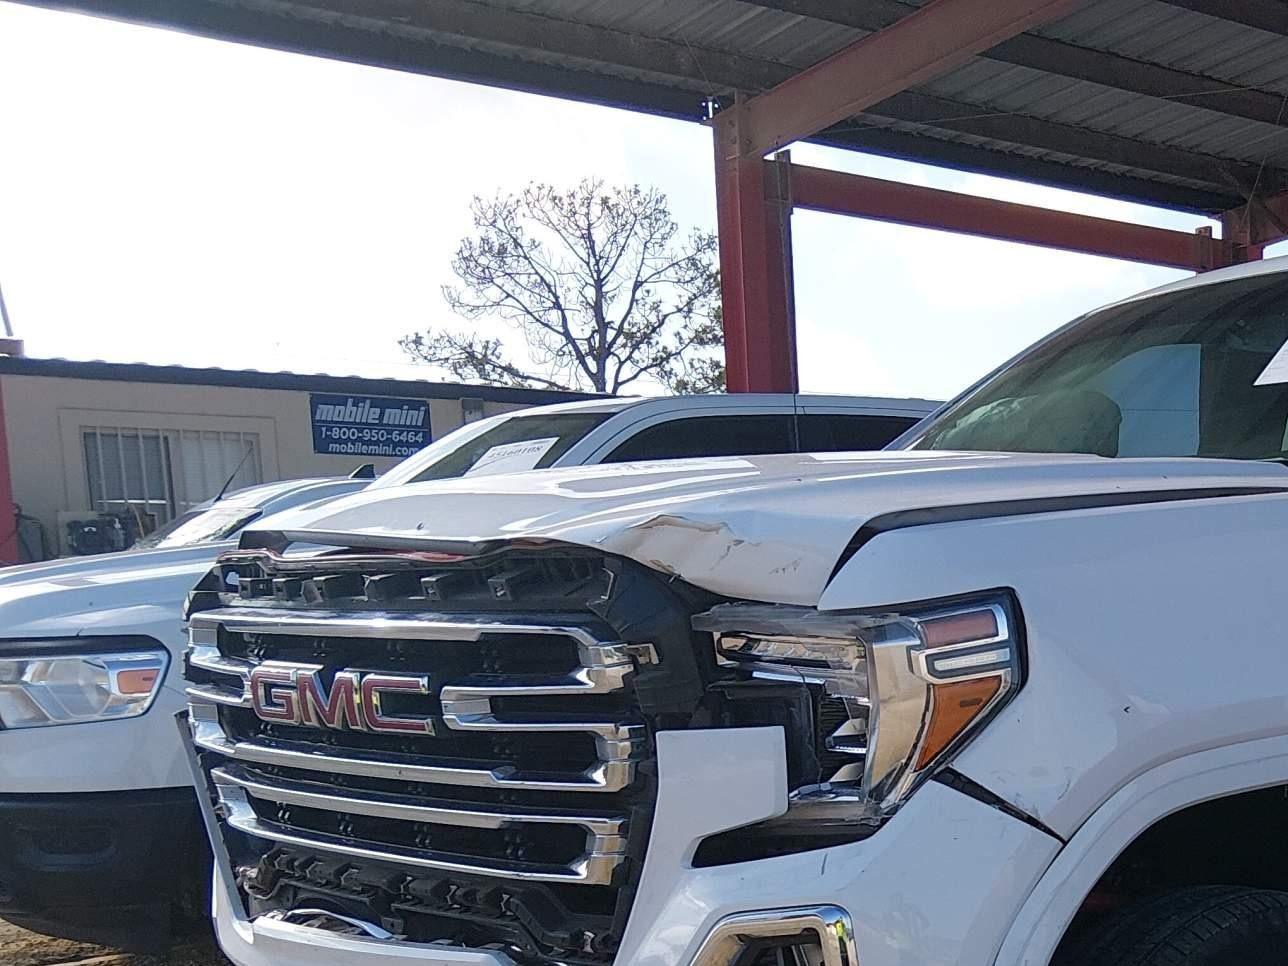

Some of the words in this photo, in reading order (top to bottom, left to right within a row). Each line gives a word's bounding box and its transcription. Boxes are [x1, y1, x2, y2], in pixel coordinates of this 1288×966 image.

[315, 398, 381, 424] mobile
[382, 405, 426, 427] mini
[321, 426, 424, 443] 1-800-950-6464
[250, 659, 436, 736] GMC
